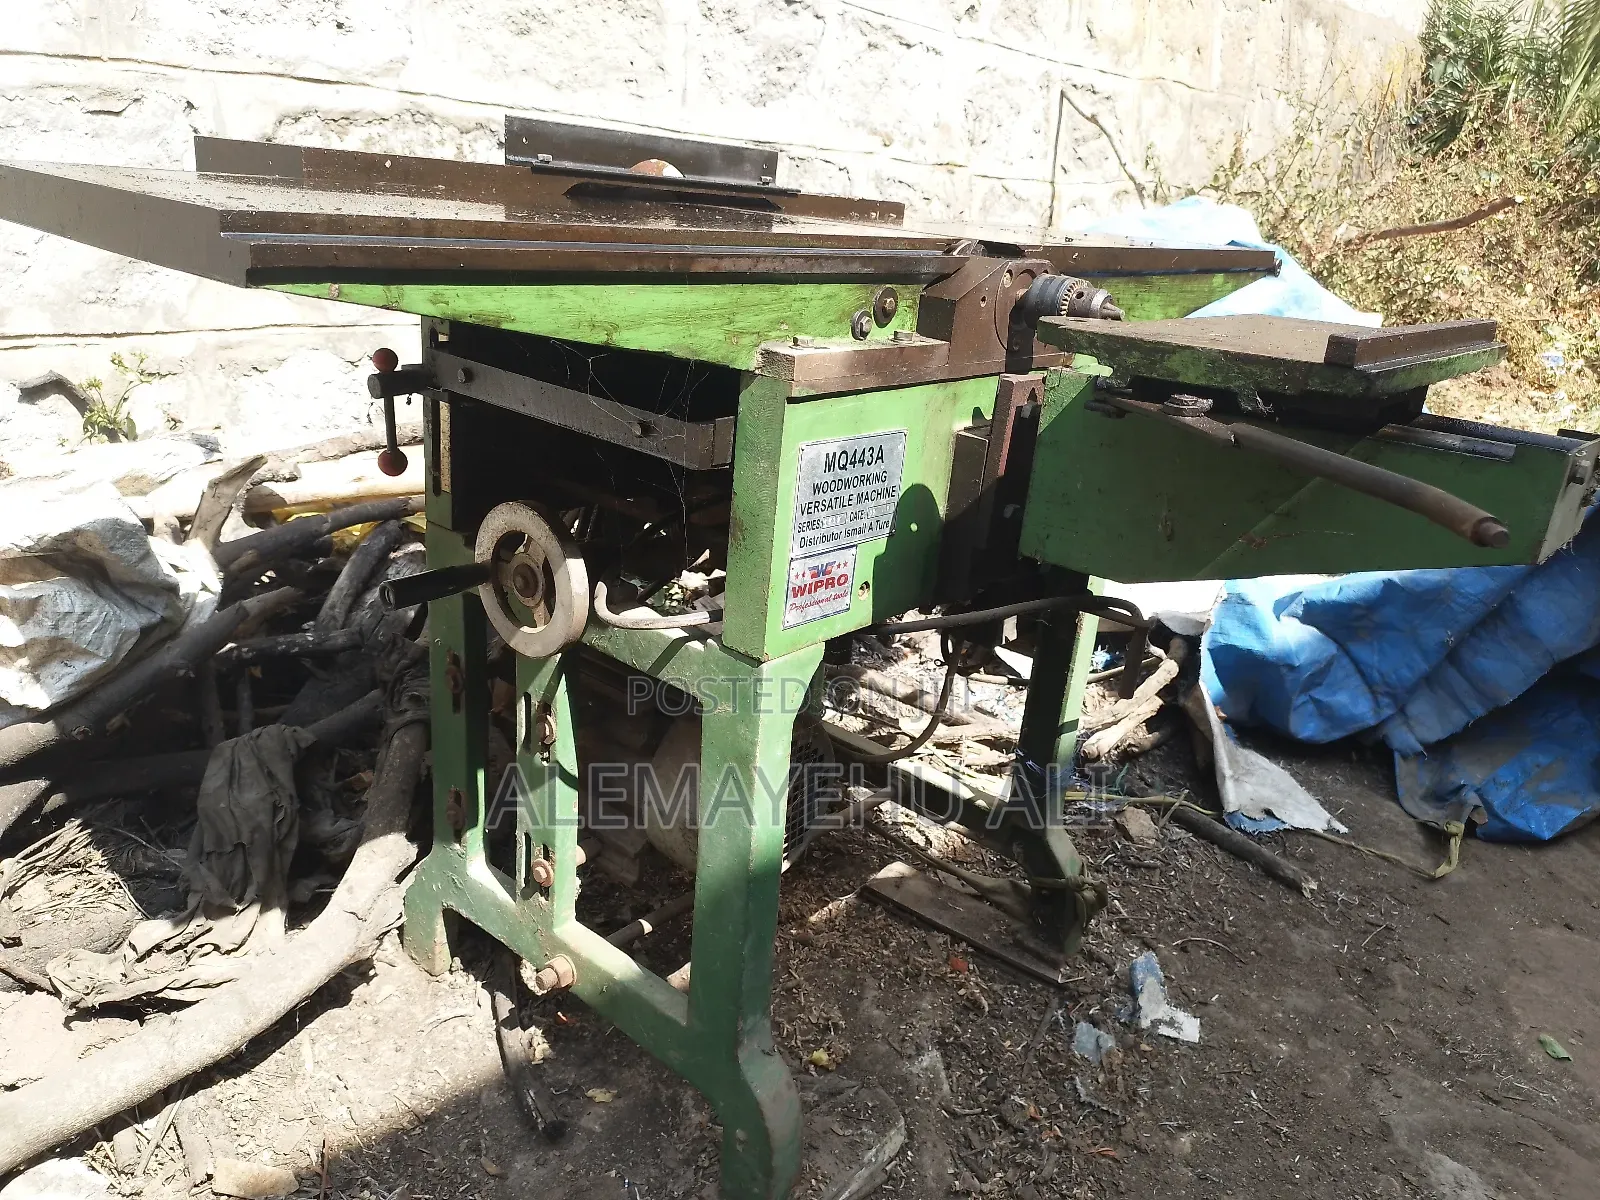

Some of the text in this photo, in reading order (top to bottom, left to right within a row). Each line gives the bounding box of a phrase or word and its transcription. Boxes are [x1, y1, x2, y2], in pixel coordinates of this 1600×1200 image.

[823, 445, 884, 473] MQ443A
[813, 471, 887, 496] WOODWORKING
[800, 494, 853, 516] VERSATILE
[856, 485, 896, 505] MACHINE
[800, 531, 842, 548] Distributor
[844, 522, 867, 538] Ismail
[867, 522, 874, 533] A
[791, 574, 849, 598] WIPRO
